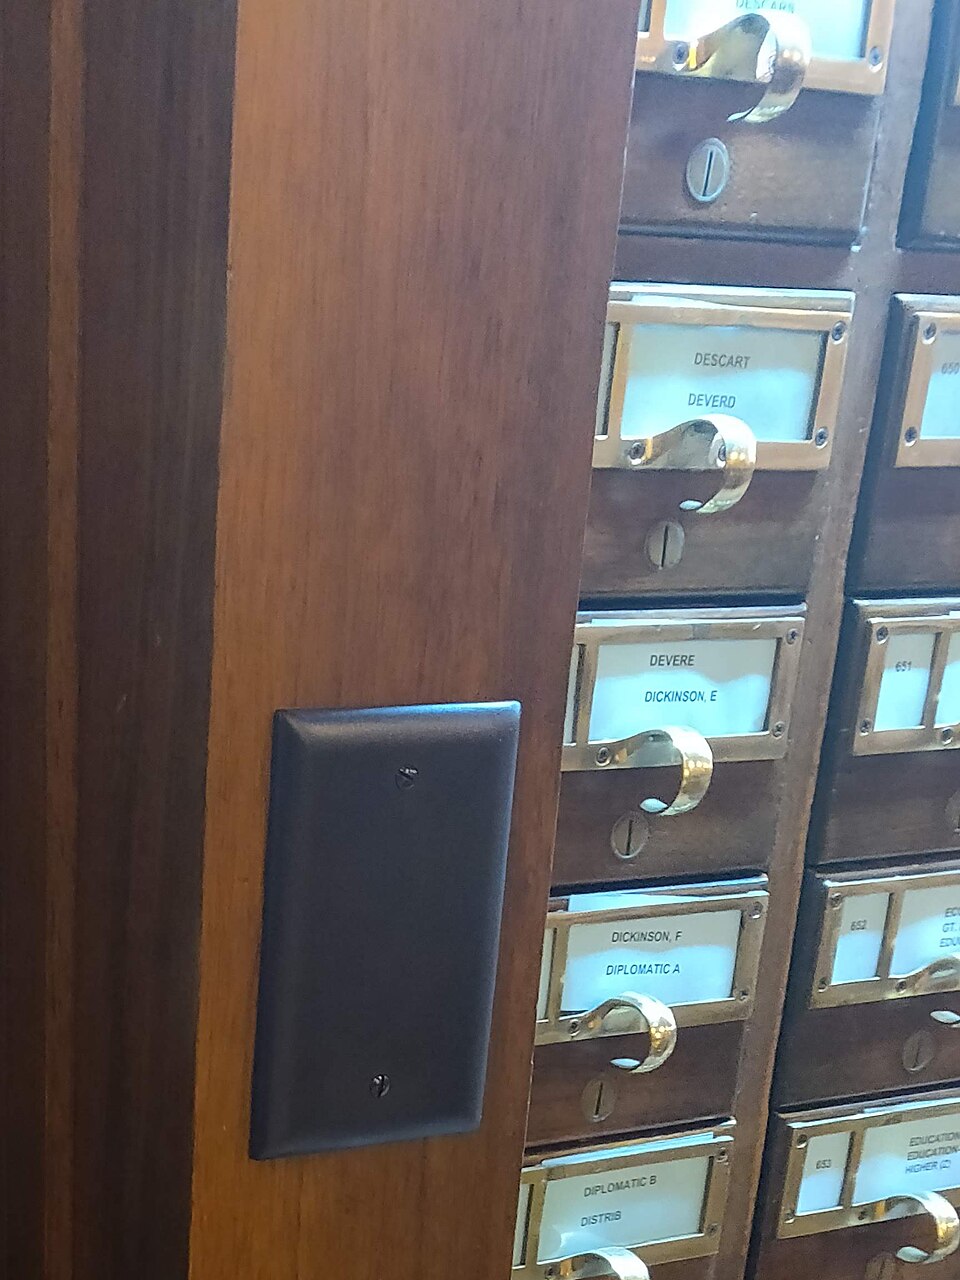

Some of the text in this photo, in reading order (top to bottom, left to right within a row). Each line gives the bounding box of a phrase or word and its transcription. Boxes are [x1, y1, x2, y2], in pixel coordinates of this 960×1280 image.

[694, 352, 751, 369] DESCART
[688, 393, 736, 409] DEVERD
[650, 655, 695, 667] DEVERE
[895, 660, 913, 672] 651
[645, 690, 717, 704] DICKINSON, E
[851, 919, 867, 931] 652
[611, 930, 682, 944] DICKINSON, F
[606, 963, 680, 976] DIPLOMATIC A
[816, 1159, 831, 1170] 653
[584, 1175, 657, 1198] DIPLOMATIC B
[581, 1210, 622, 1227] DISTRIB
